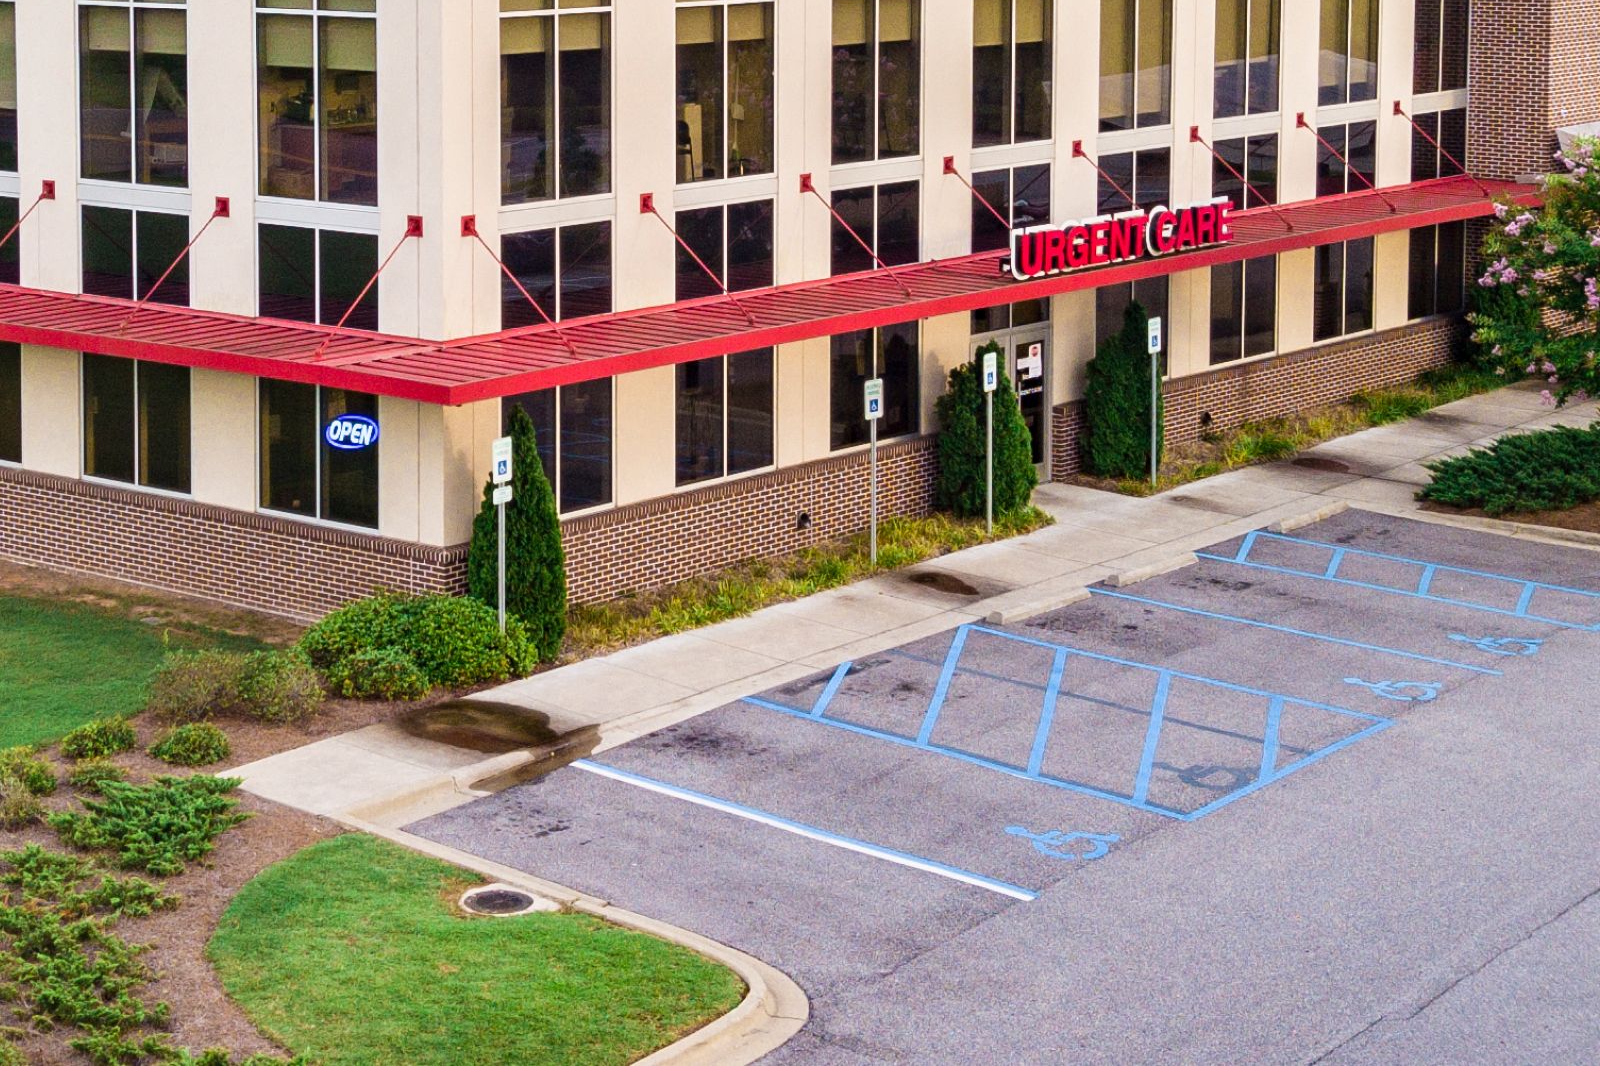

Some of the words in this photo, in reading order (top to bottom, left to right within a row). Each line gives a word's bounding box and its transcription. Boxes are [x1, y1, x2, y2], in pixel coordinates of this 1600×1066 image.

[1013, 211, 1148, 280] URGENT
[1148, 197, 1234, 255] CARE
[329, 420, 374, 446] OPEN
